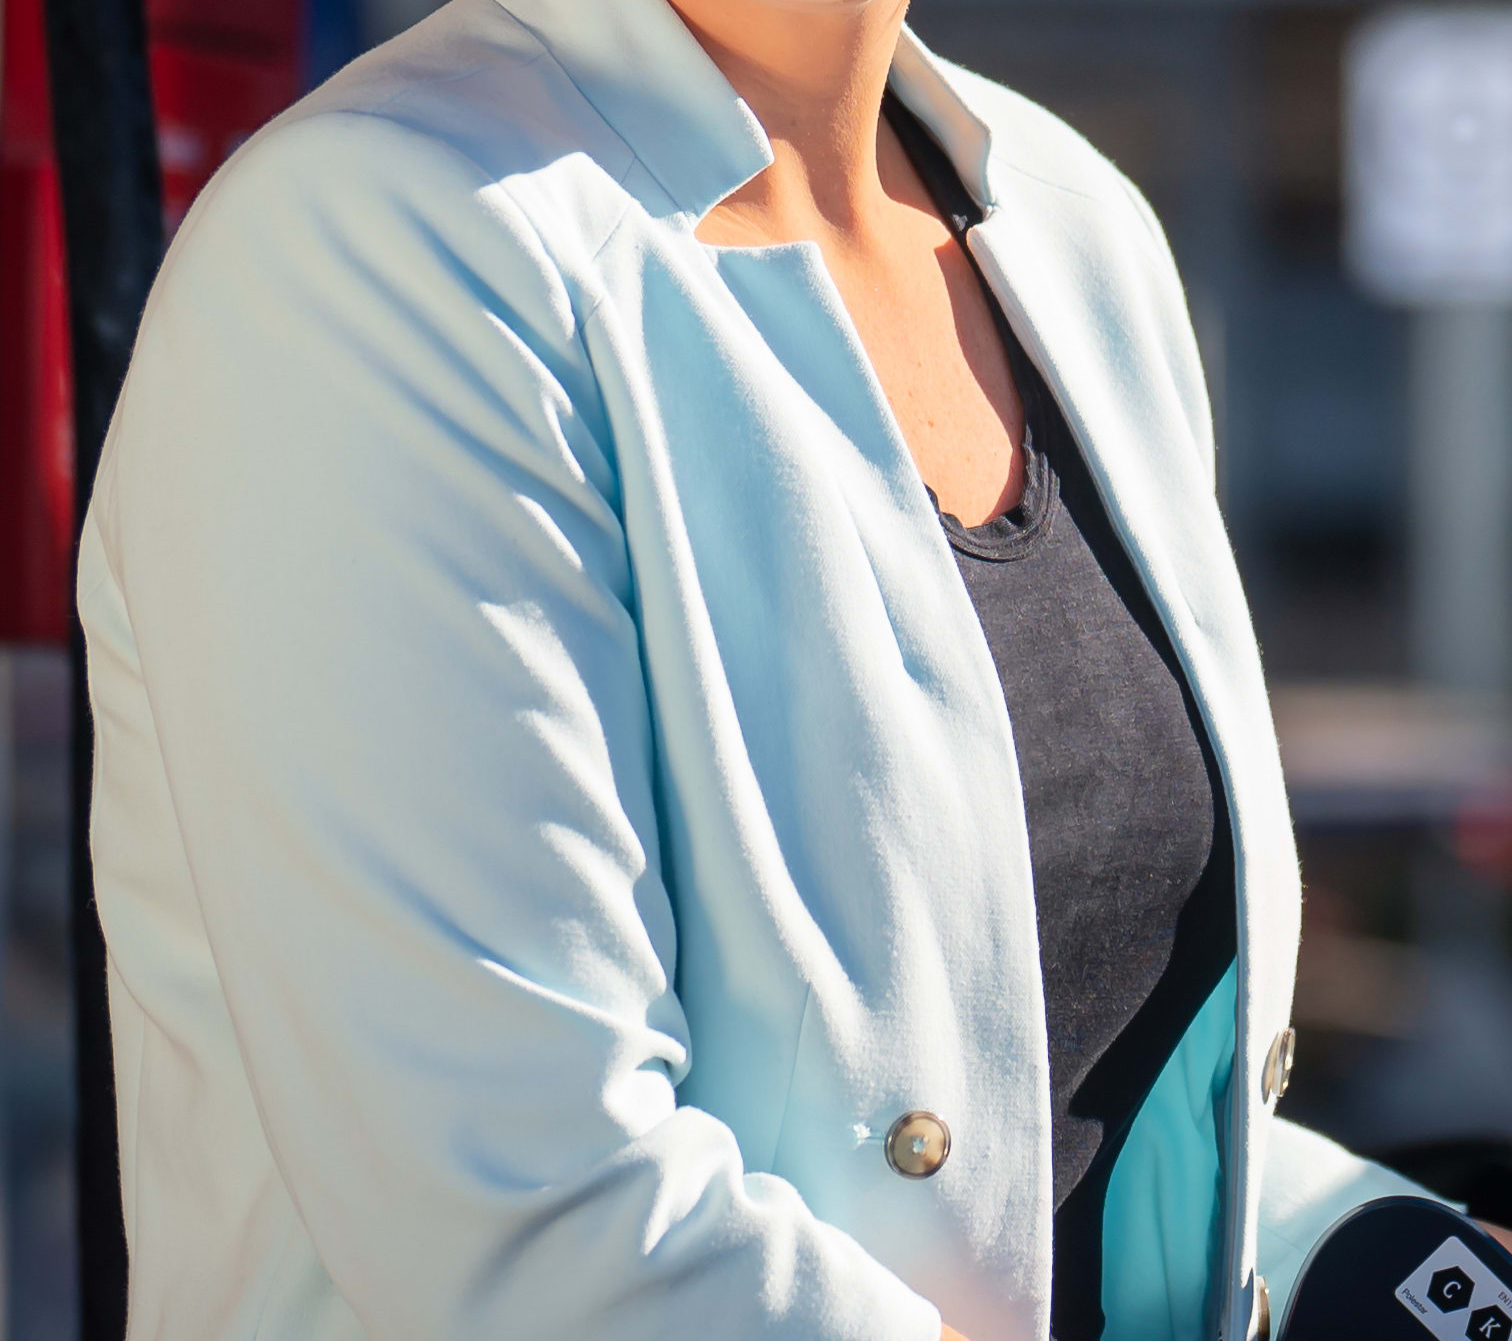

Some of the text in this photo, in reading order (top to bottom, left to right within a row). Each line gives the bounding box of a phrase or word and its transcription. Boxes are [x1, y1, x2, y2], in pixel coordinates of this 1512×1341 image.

[1402, 1288, 1428, 1315] Polestar
[1443, 1281, 1462, 1299] C
[1479, 1317, 1501, 1339] K
